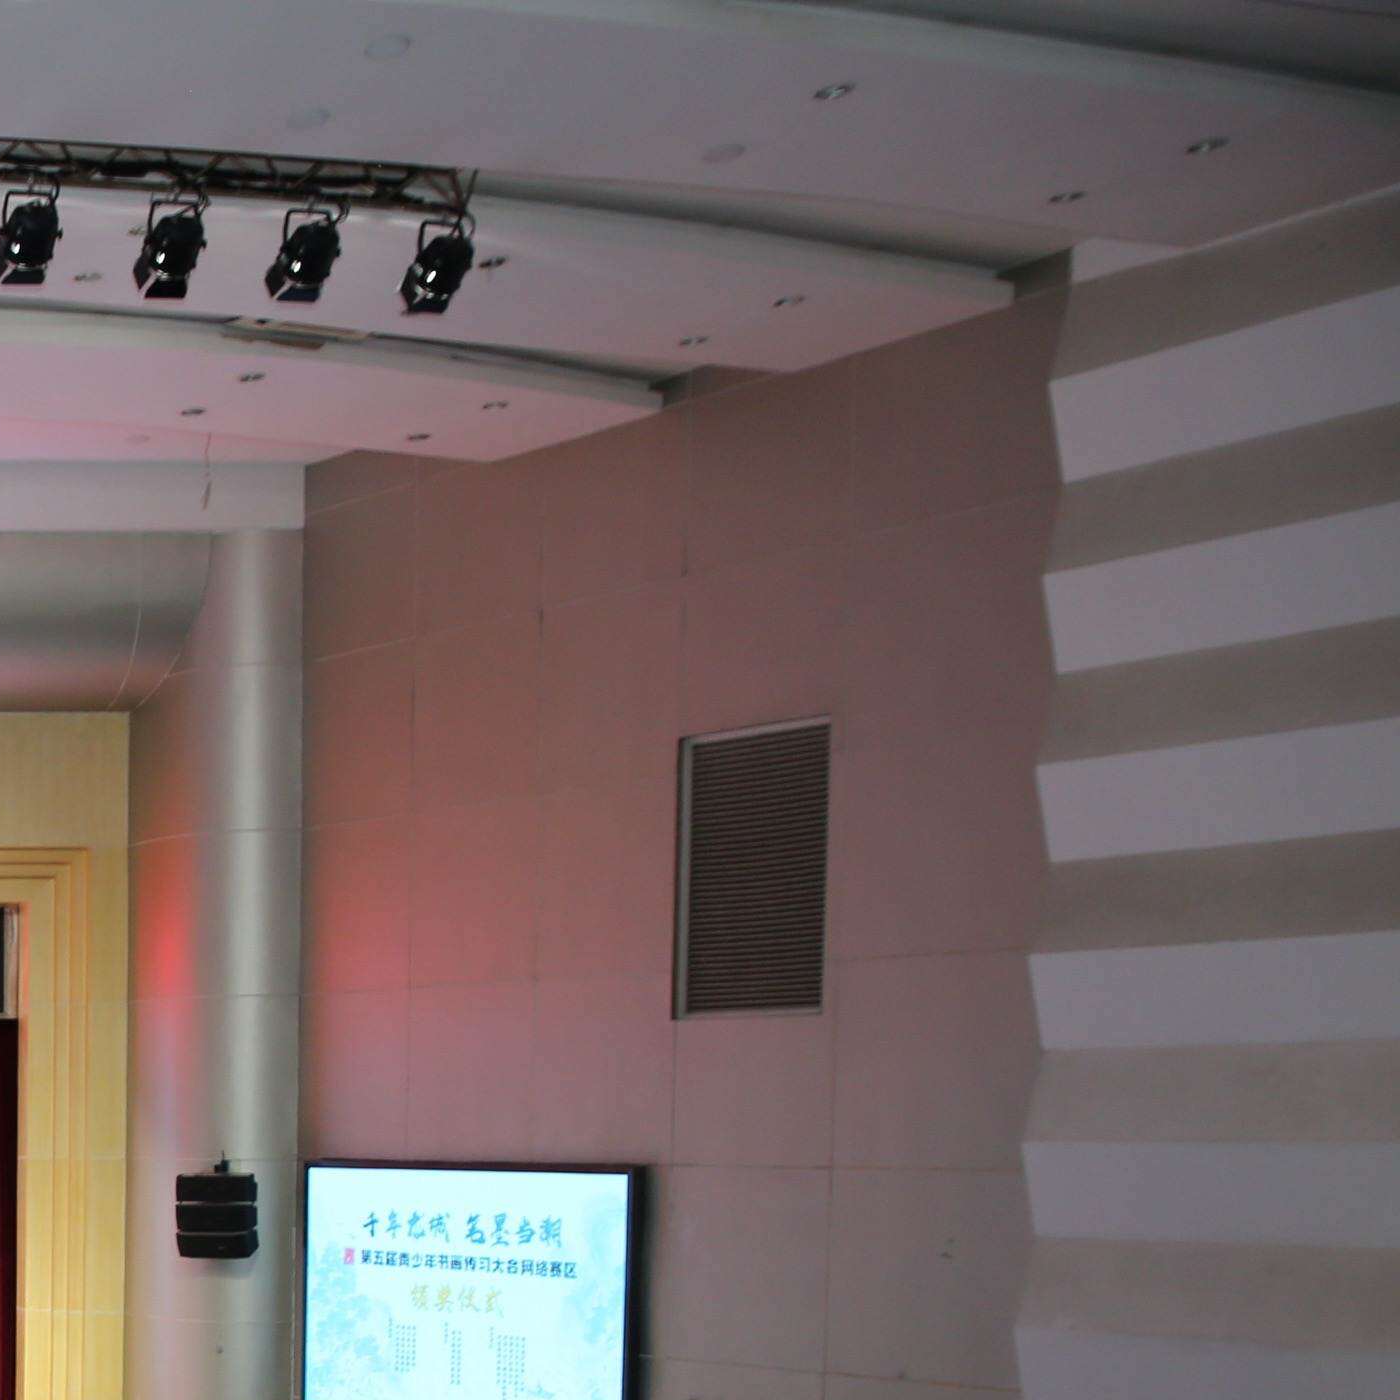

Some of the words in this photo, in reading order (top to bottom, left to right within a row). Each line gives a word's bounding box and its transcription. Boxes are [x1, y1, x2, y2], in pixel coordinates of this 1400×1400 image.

[361, 1249, 578, 1280] 第五届青少年书画传习大会网络赛区
